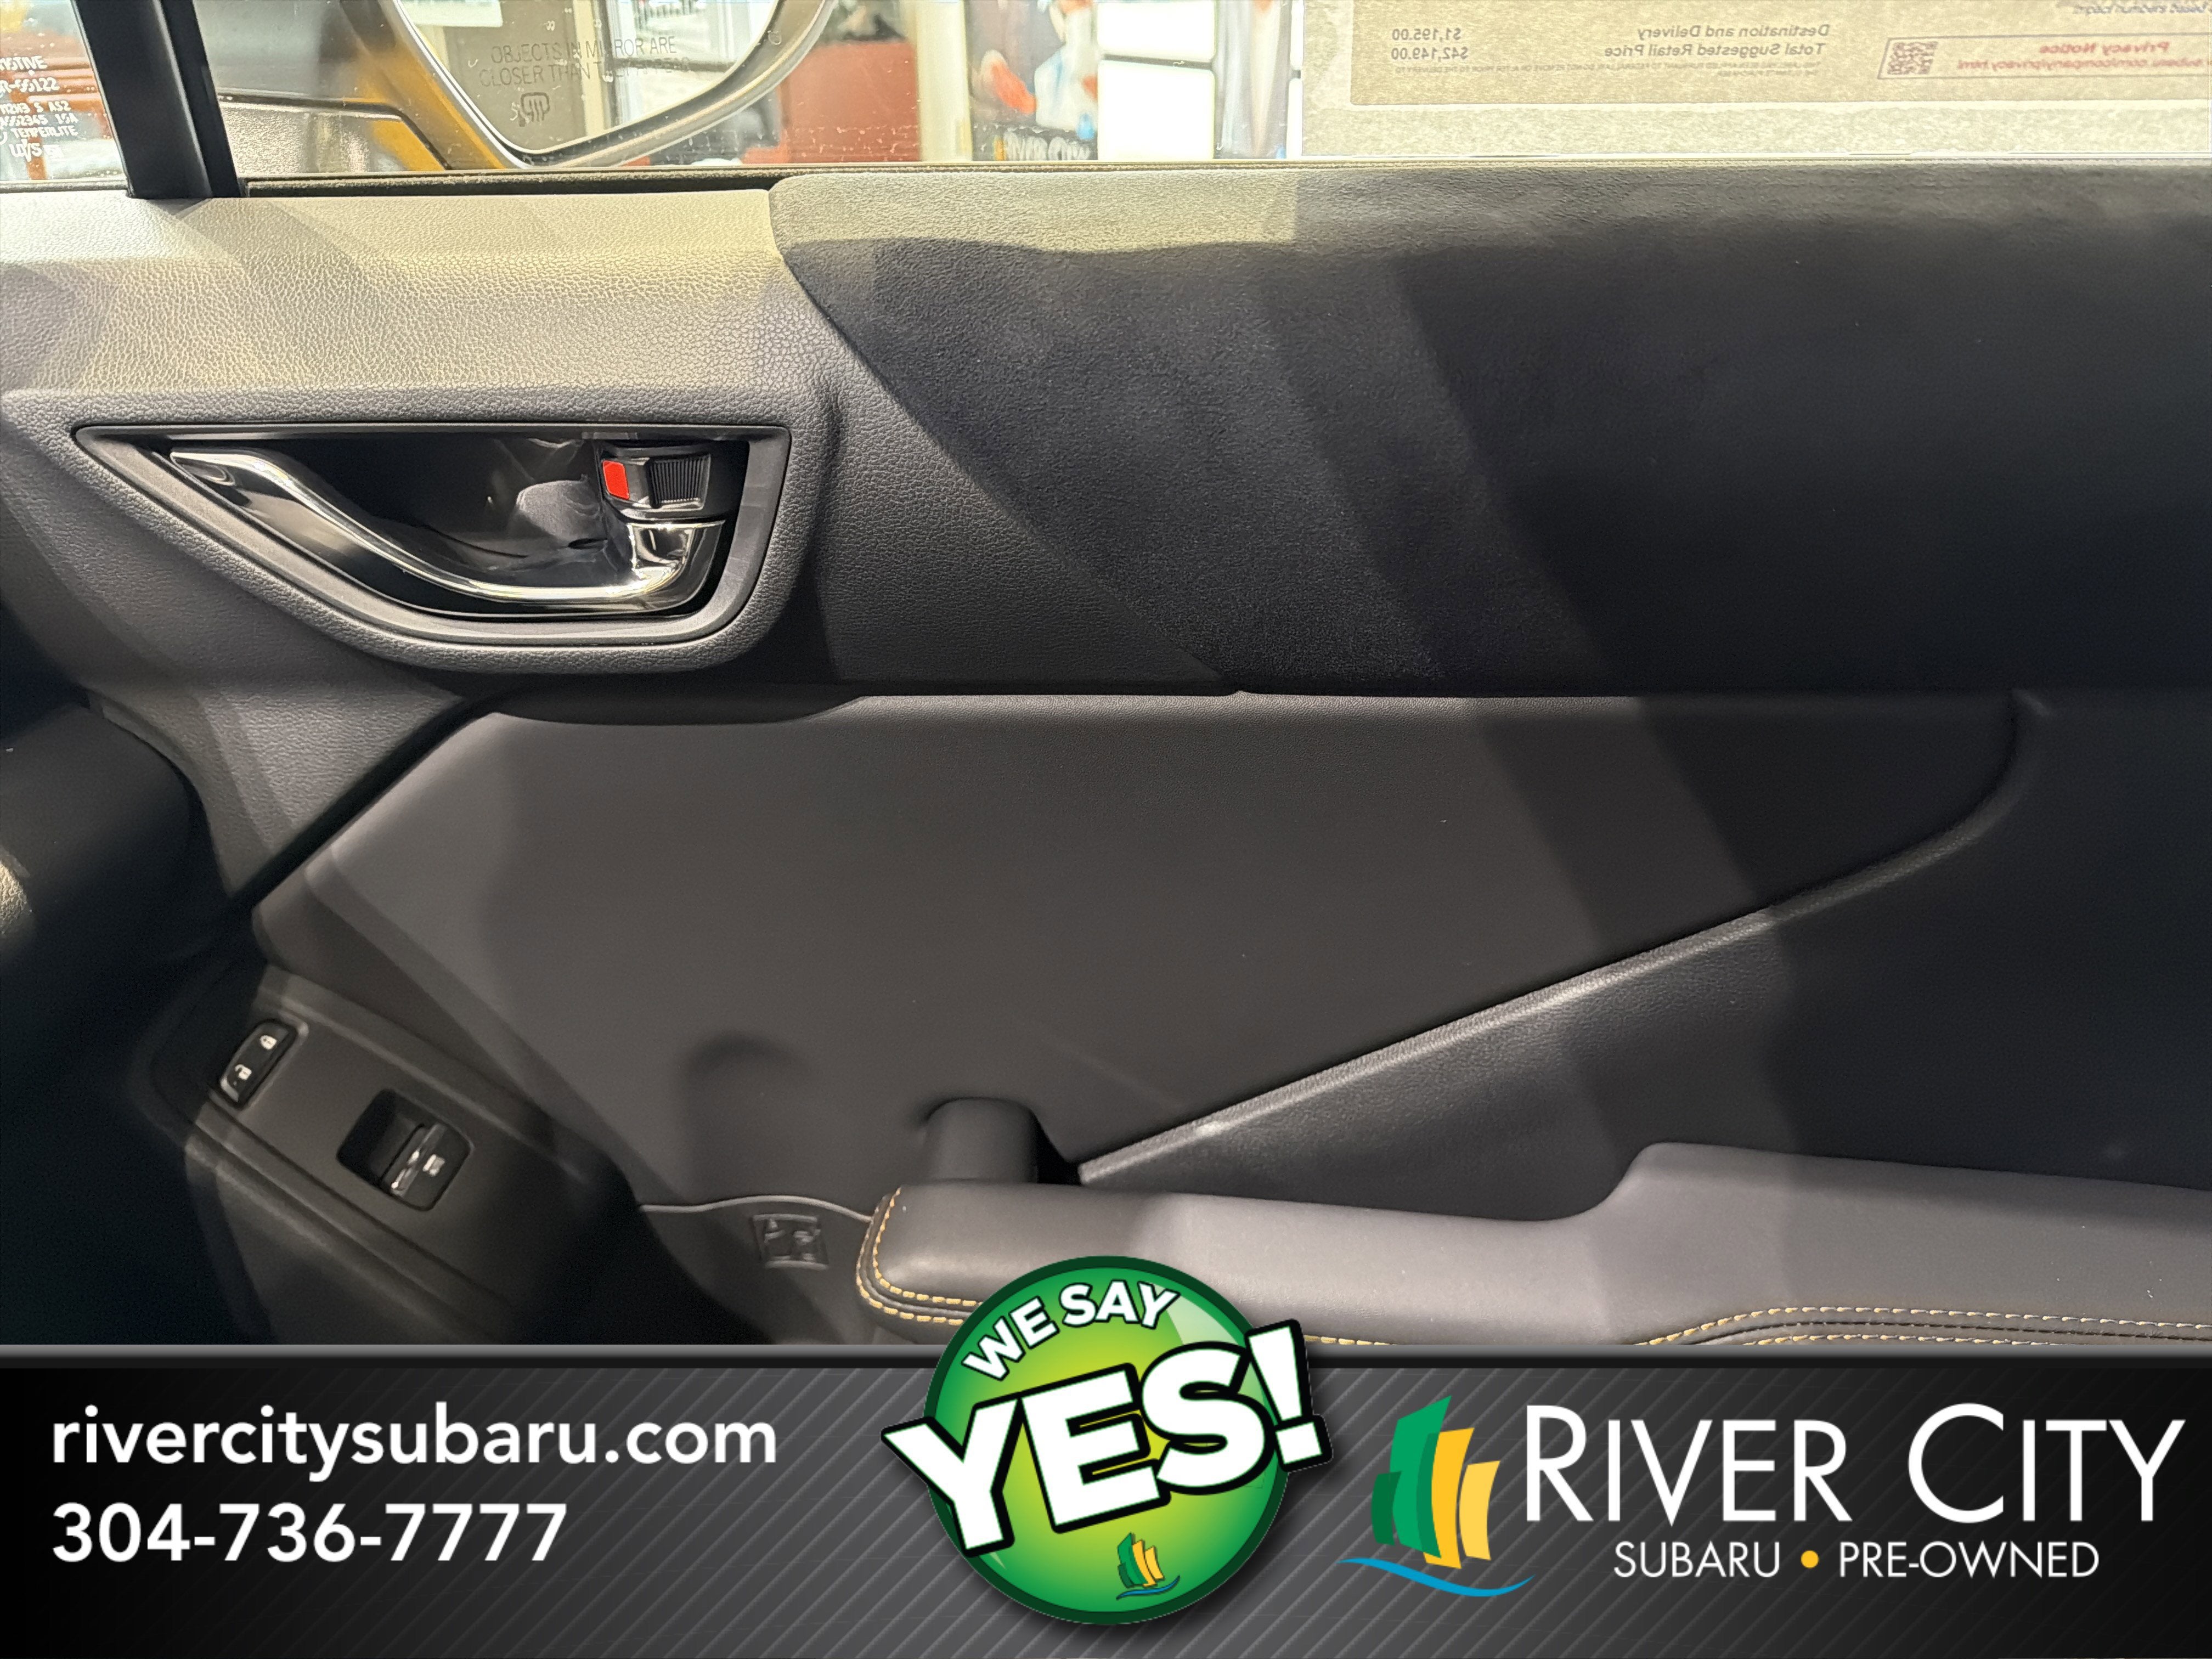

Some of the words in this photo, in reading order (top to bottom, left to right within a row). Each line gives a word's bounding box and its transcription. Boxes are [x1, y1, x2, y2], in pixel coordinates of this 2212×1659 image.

[491, 42, 562, 64] OBJECTS
[585, 38, 644, 58] MIROR
[650, 36, 678, 54] ARE
[479, 65, 544, 87] CLOSER
